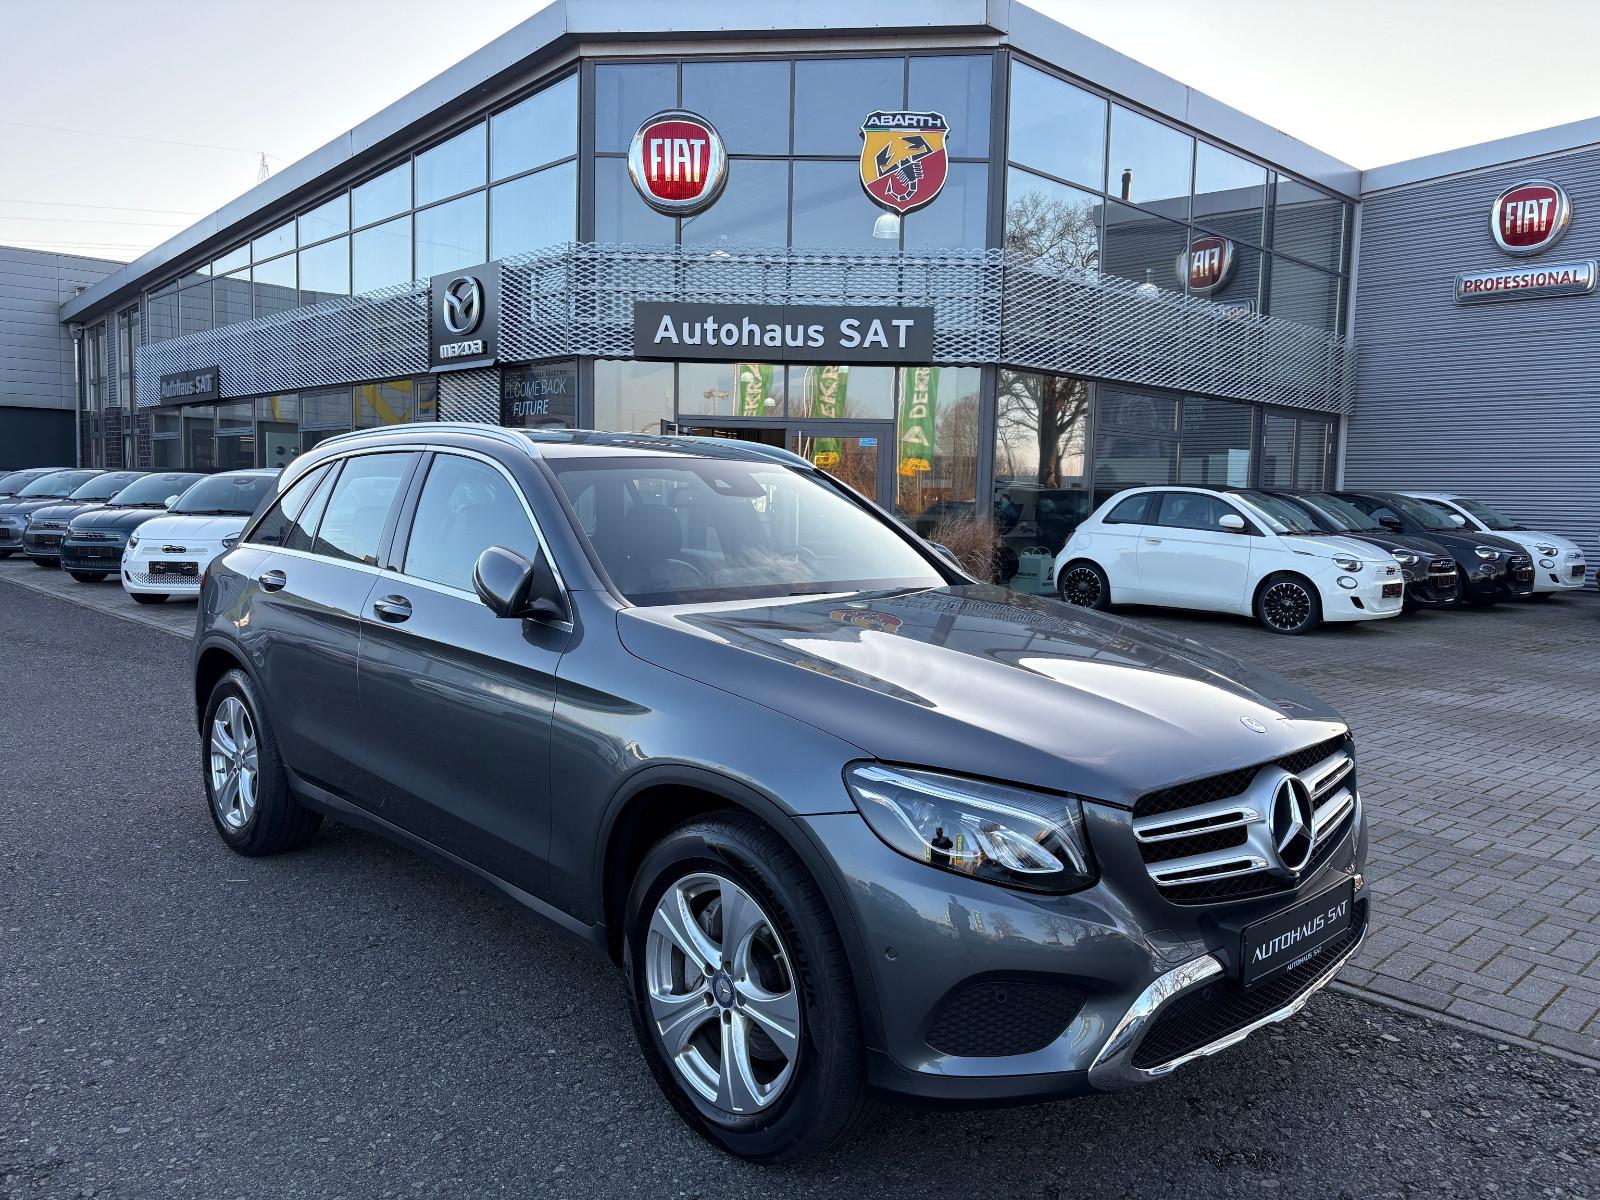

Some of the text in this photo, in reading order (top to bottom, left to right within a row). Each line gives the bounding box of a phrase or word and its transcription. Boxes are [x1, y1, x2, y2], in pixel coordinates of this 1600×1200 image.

[867, 114, 941, 127] ABARTH
[650, 139, 706, 182] FIAT
[1506, 198, 1553, 234] FIAT
[1463, 269, 1580, 293] PROFESSIONAL
[654, 315, 914, 349] Autohaus SAT
[161, 374, 213, 399] Autohaus SAT
[513, 399, 549, 416] FUTURE
[1252, 900, 1348, 964] AUTOHAUS SAT
[1286, 952, 1313, 971] AUTOHAUS
